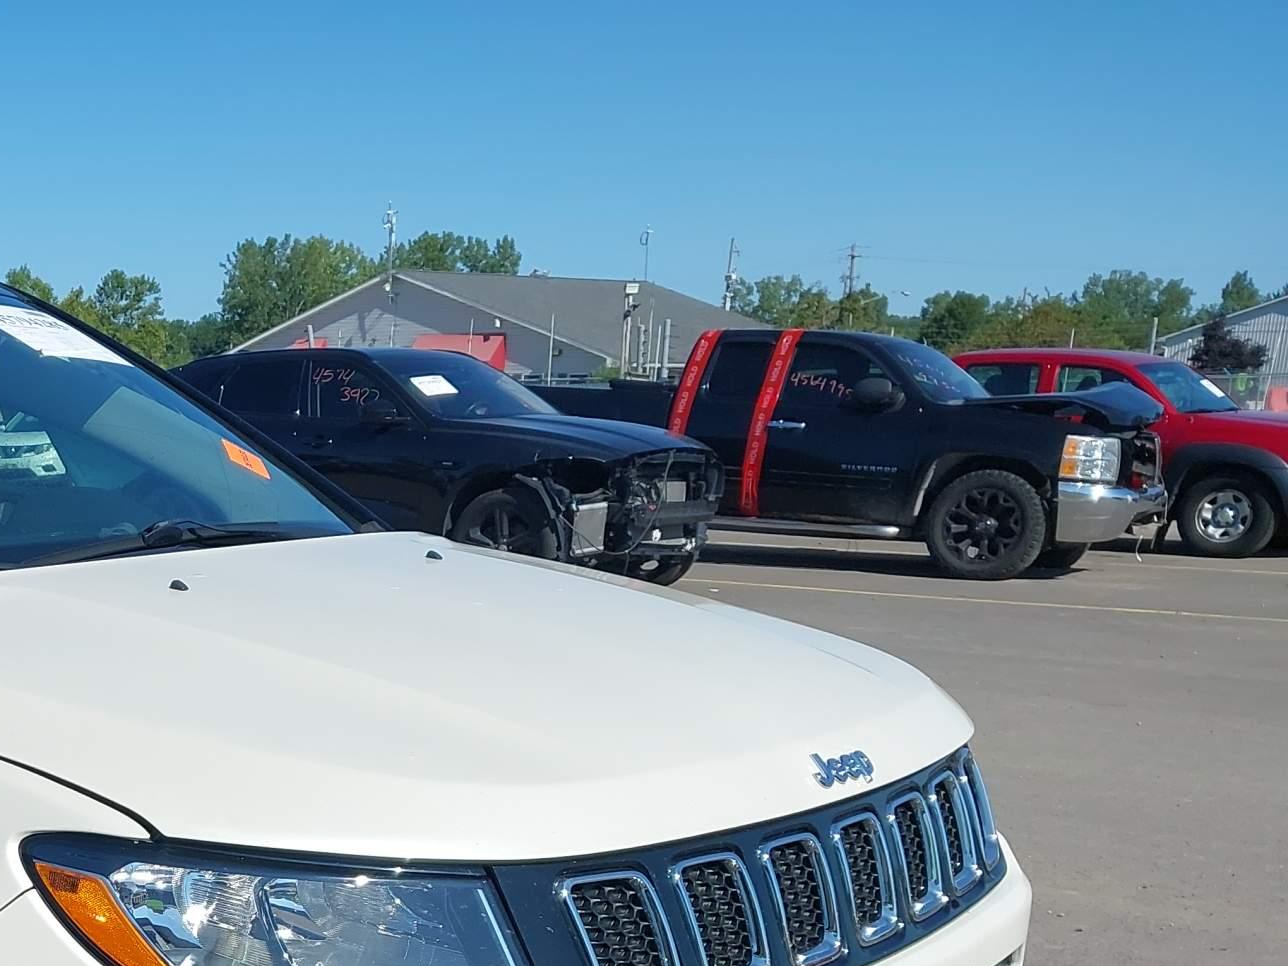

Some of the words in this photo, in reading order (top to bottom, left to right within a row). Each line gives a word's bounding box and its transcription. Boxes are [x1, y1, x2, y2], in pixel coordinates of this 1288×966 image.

[677, 391, 689, 413] HOLD
[686, 365, 698, 387] HOLD
[749, 441, 759, 464] HOLD
[754, 412, 765, 436] HOLD
[770, 360, 783, 381] HOLD
[808, 750, 874, 788] Jeep
